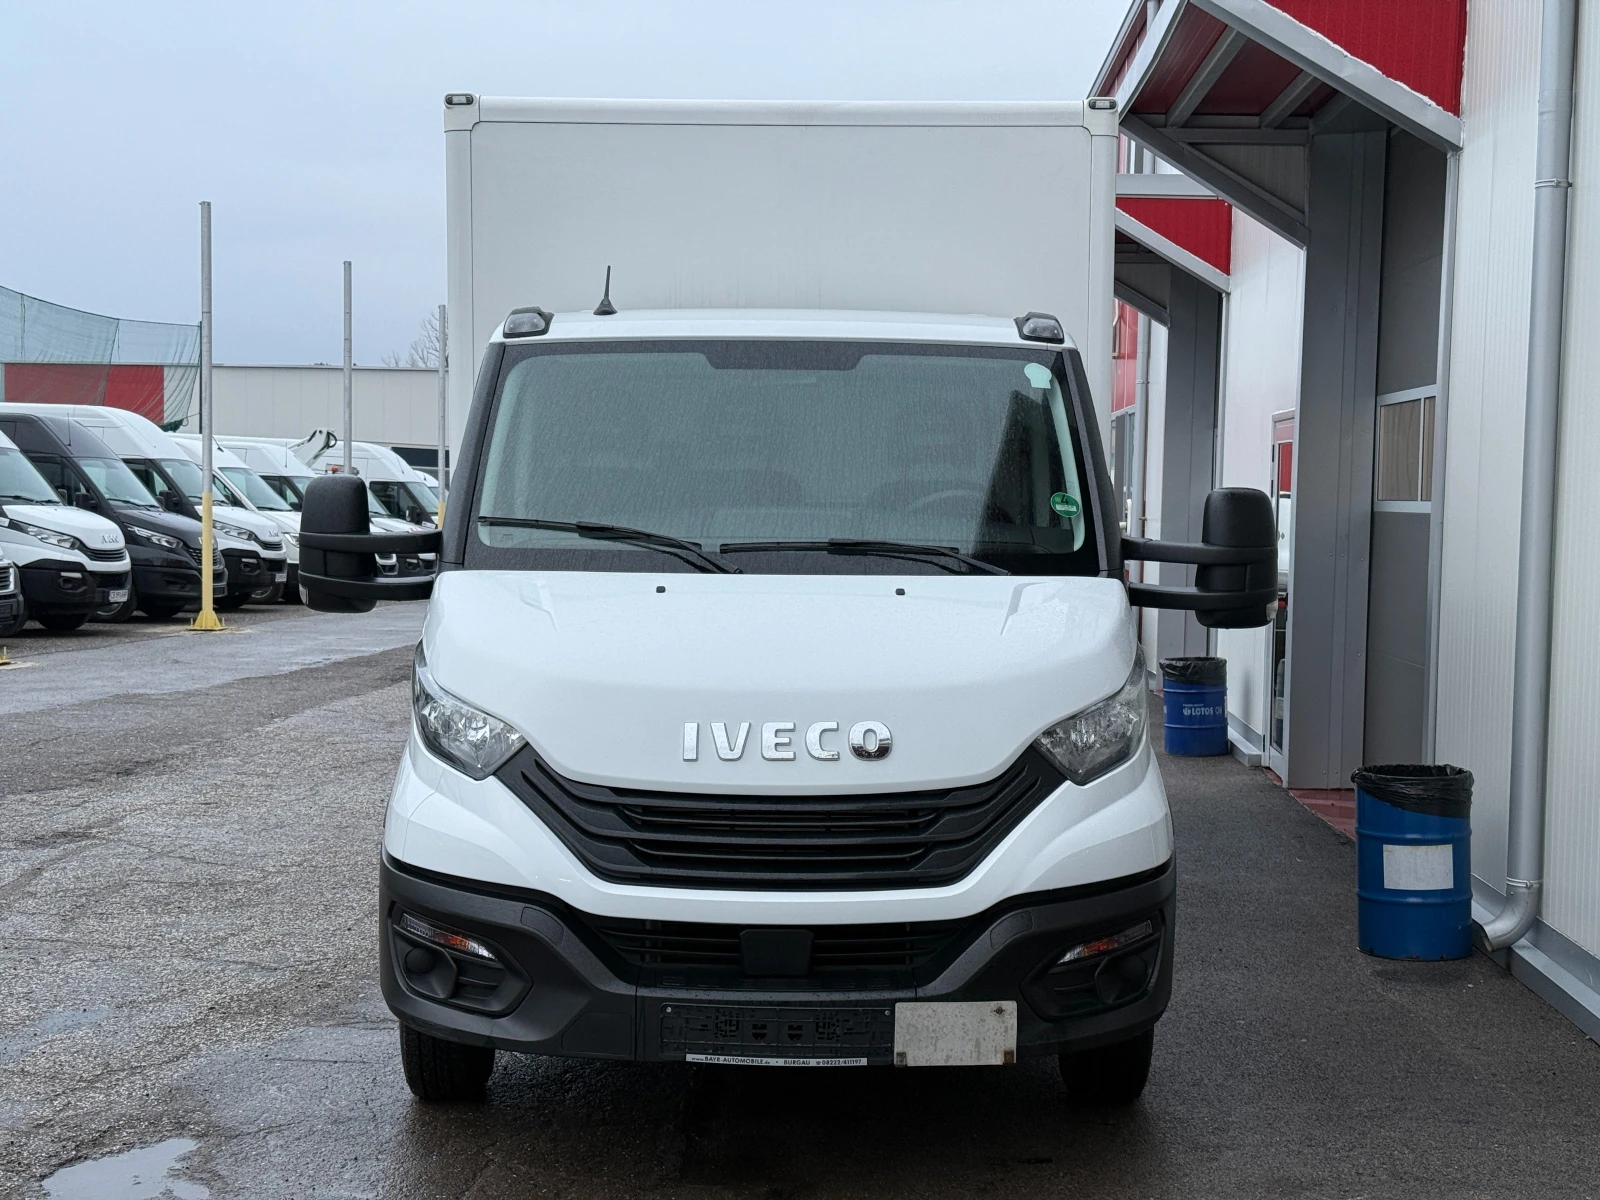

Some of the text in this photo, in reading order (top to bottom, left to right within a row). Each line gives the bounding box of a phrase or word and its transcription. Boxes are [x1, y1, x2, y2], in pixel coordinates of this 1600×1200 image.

[1061, 494, 1069, 505] 4
[1191, 706, 1214, 715] LOTOS
[683, 720, 893, 762] IVECO
